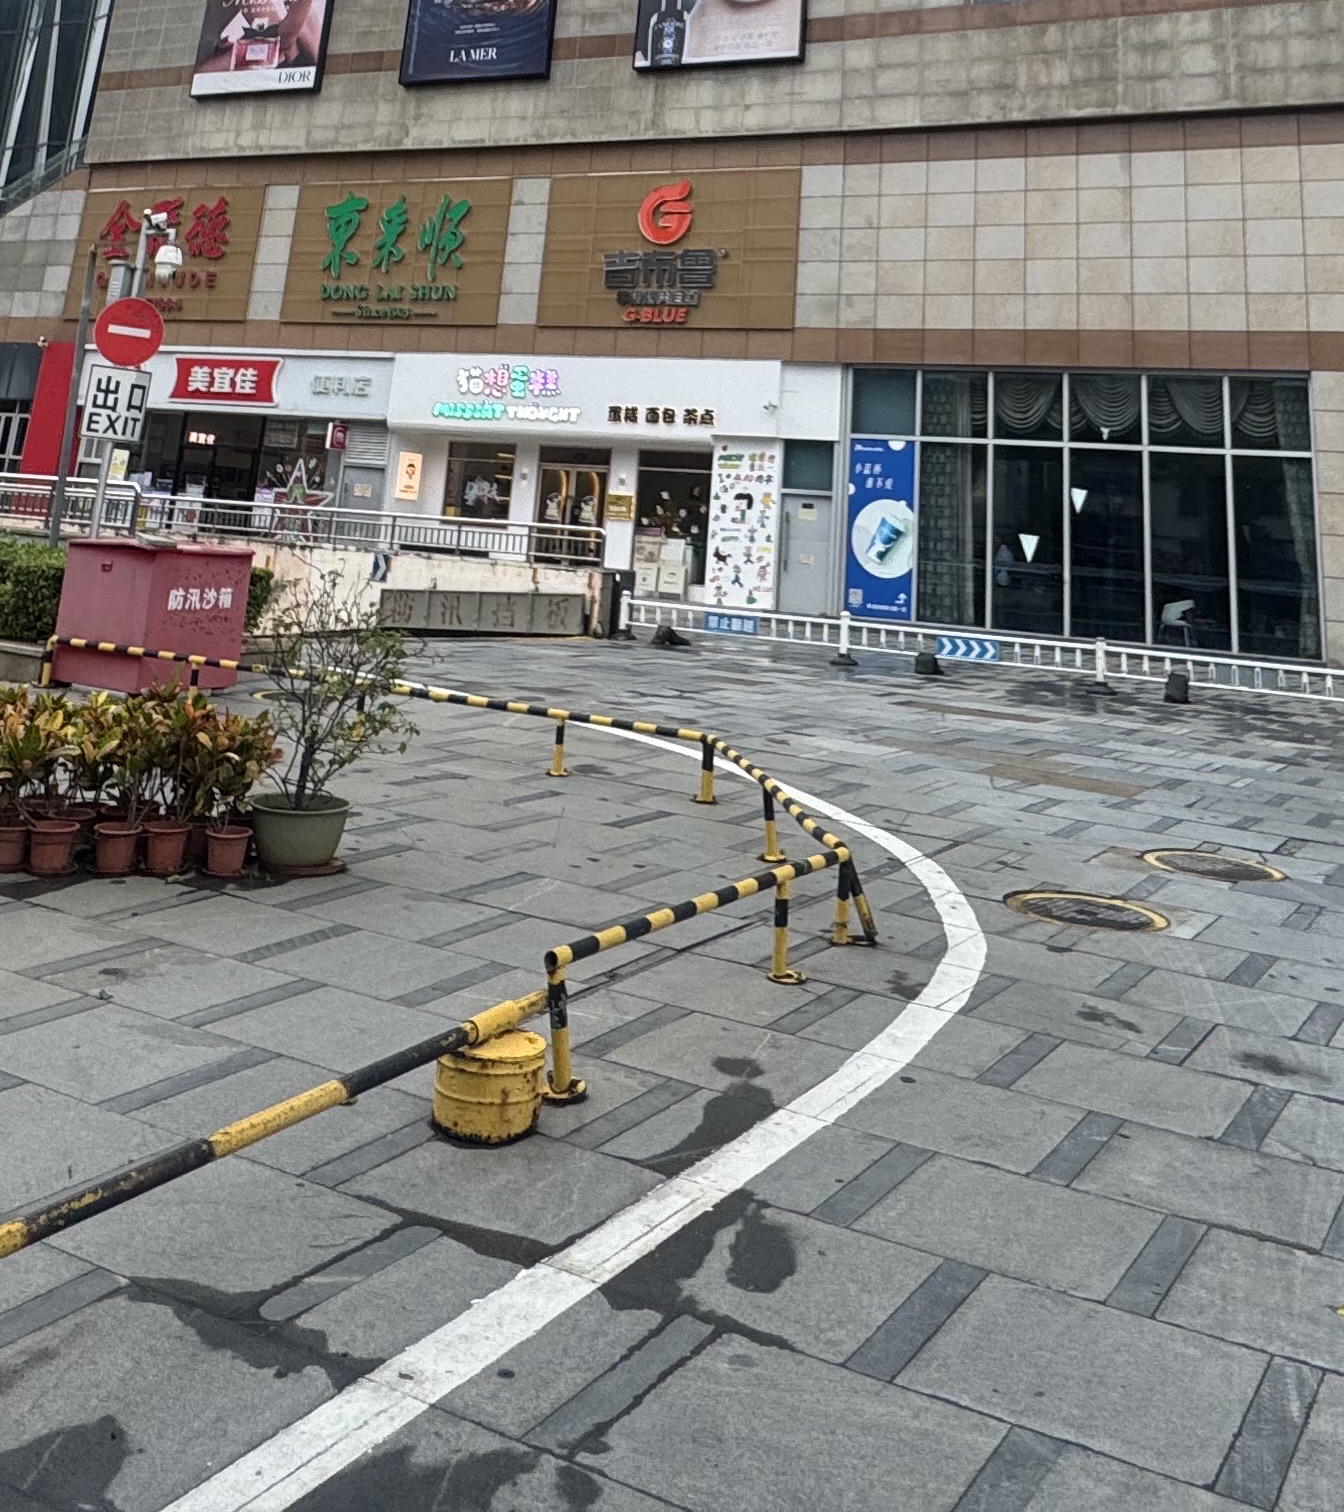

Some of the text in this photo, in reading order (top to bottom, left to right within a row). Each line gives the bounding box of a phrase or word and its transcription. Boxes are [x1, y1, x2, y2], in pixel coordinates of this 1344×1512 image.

[449, 47, 498, 63] LA MER
[277, 69, 311, 85] DIOR
[602, 249, 717, 288] 吉布鲁
[320, 284, 457, 301] DONG LAI SHUN
[622, 306, 688, 324] G-BLUE
[188, 366, 259, 394] 美宜佳
[92, 375, 146, 412] 出口
[86, 412, 141, 437] EXIT
[645, 407, 676, 424] 面包
[167, 587, 234, 611] 防汛沙箱
